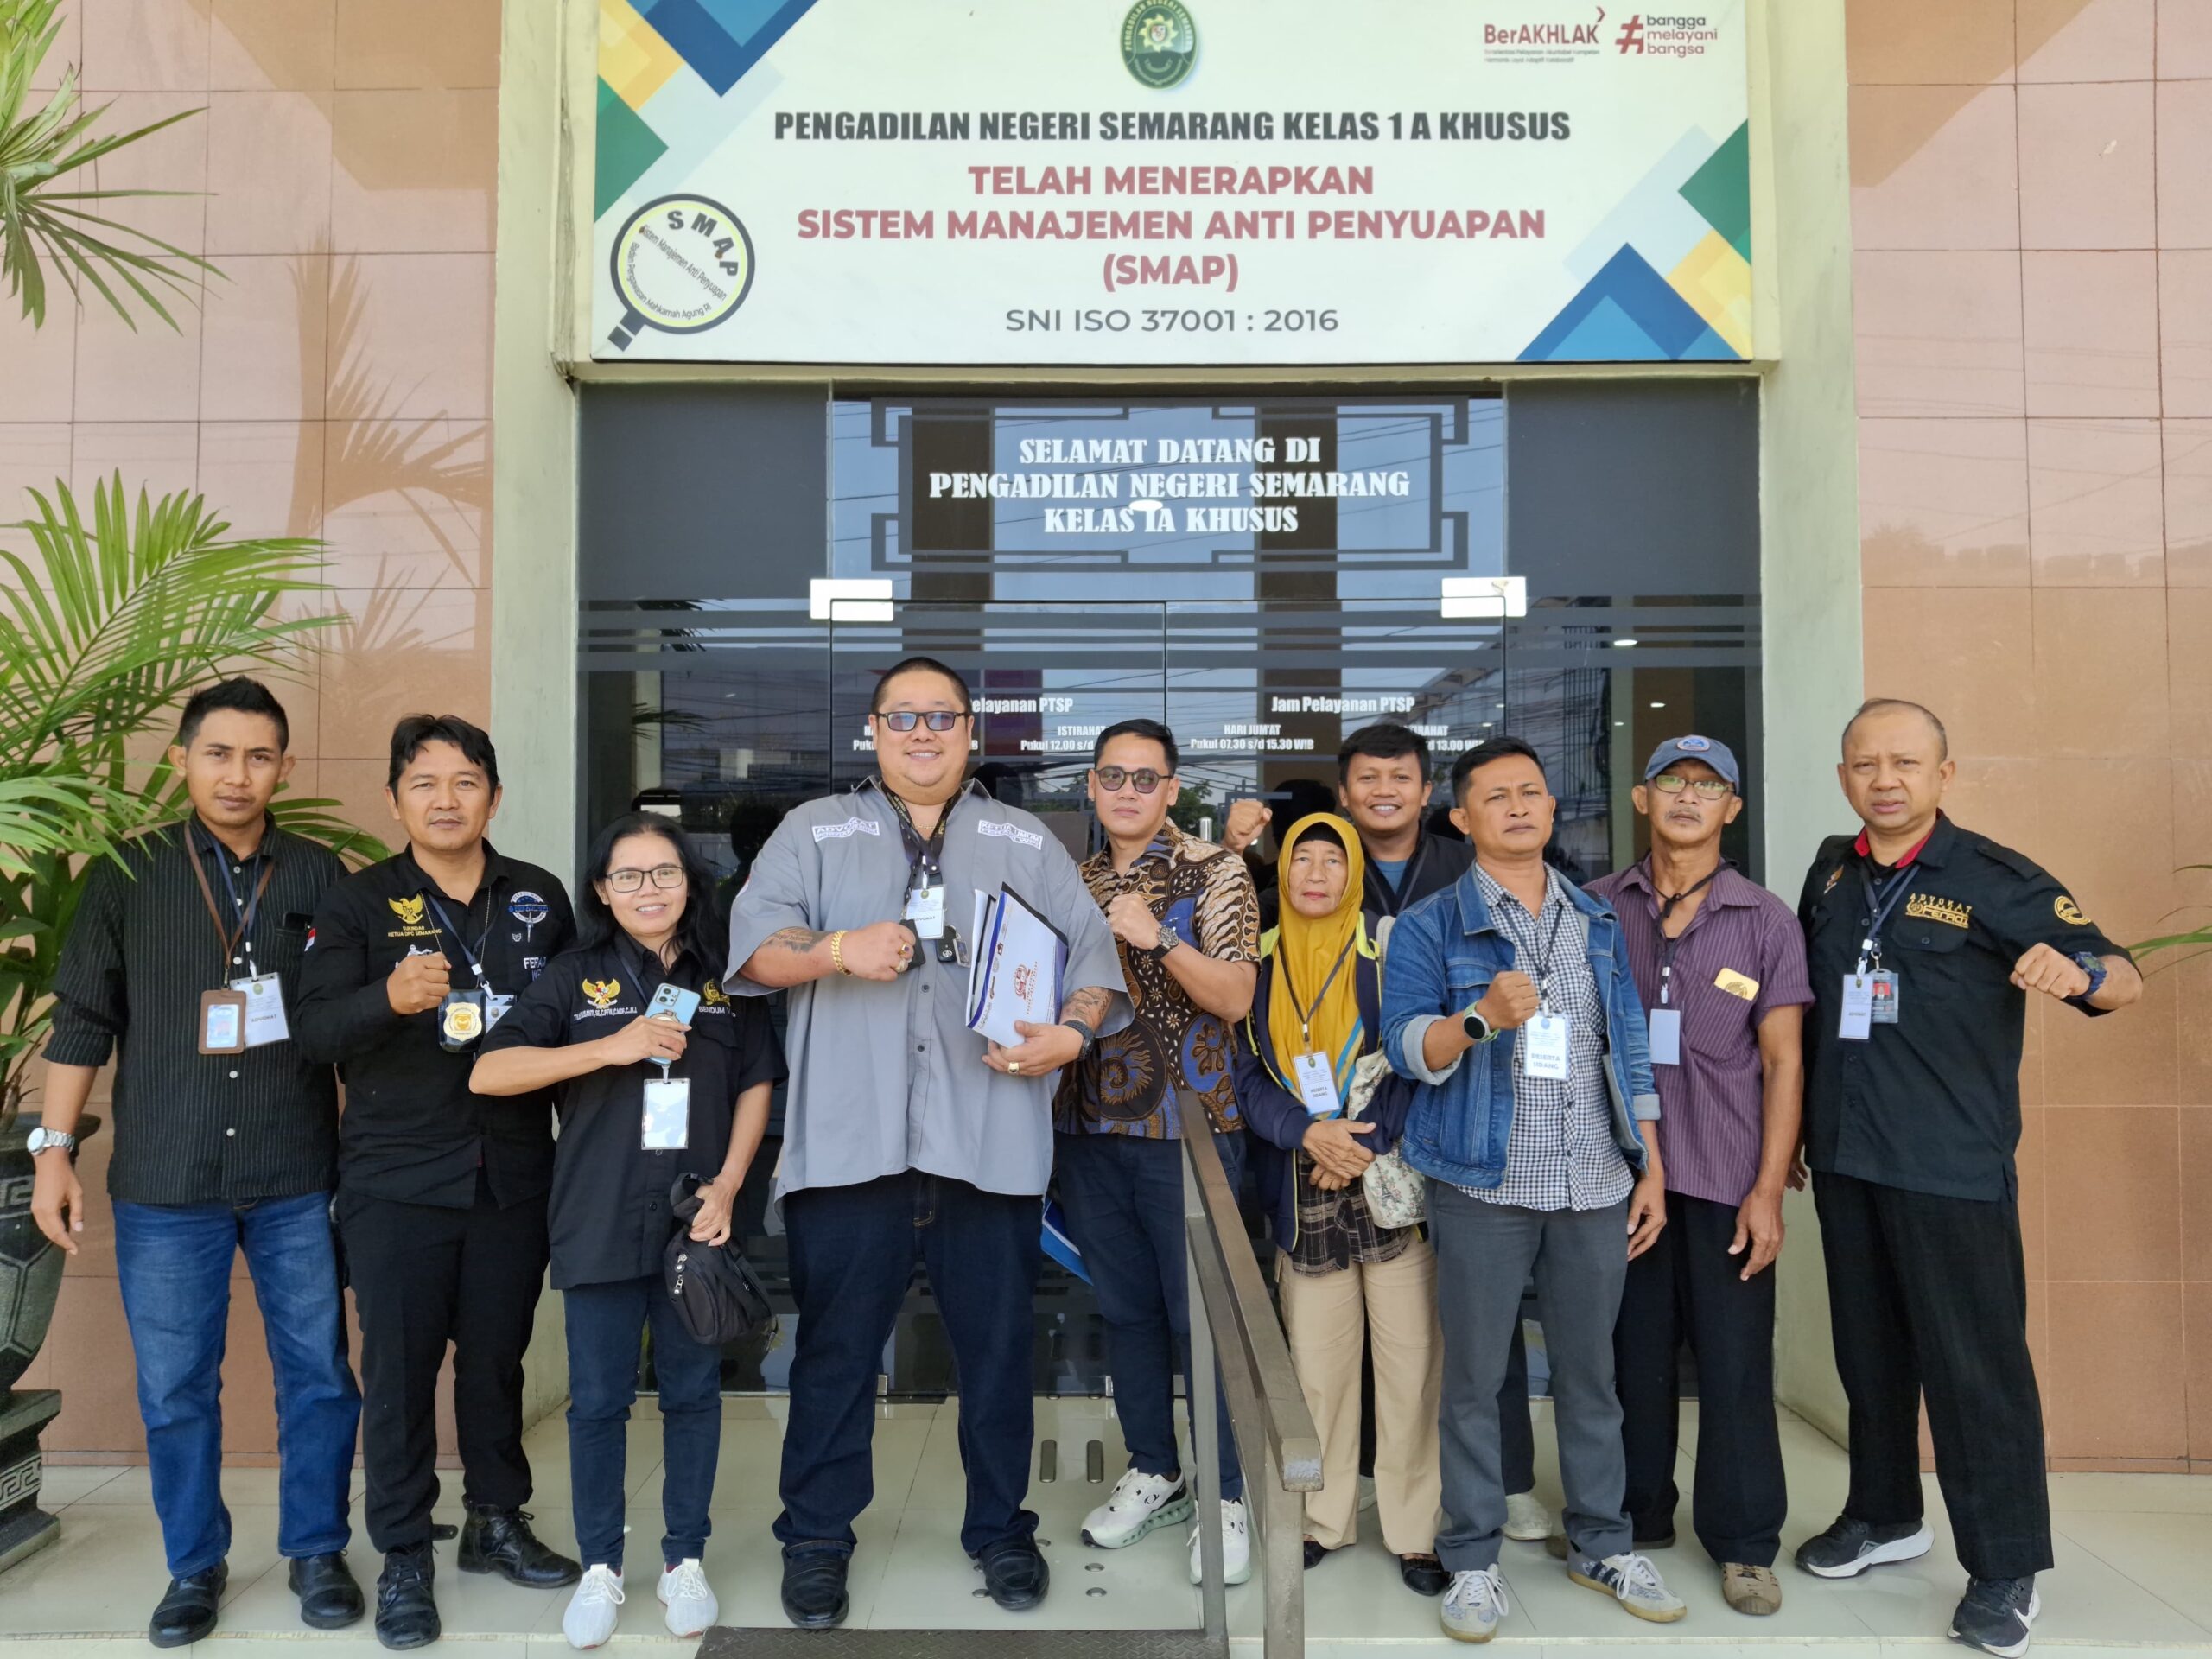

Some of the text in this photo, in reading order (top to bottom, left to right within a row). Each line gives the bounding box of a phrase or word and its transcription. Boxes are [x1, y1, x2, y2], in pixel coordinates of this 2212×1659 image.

[1646, 15, 1707, 29] bangga
[1484, 24, 1599, 44] BerAKHLAK
[1646, 29, 1718, 43] melayani
[1646, 43, 1705, 58] bangsa
[775, 111, 1571, 141] PENGADILAN NEGERI SEMARANG KELAS 1 A KHUSUS
[968, 166, 1373, 194] TELAH MENERAPKAN
[798, 209, 1545, 239] SISTEM MANAJEMEN ANTI PENYUAPAN
[658, 238, 690, 270] Manajemen
[686, 263, 702, 278] Anti
[696, 271, 728, 302] Penyuapan
[1103, 254, 1239, 293] (SMAP)
[626, 264, 648, 302] Pengawasan
[645, 299, 681, 319] Mahkamah
[682, 304, 705, 320] Agung
[1006, 309, 1061, 332] SNI
[1075, 309, 1131, 332] ISO
[1141, 309, 1235, 333] 37001
[1263, 309, 1339, 332] 2016
[1020, 437, 1321, 464] SELAMAT DATANG DI
[930, 472, 1409, 499] PENGADILAN NEGERI SEMARANG
[1044, 508, 1135, 533] KELAS
[1186, 507, 1299, 532] KHUSUS
[971, 697, 1073, 714] elayanan PTSP
[1271, 696, 1416, 714] Jam Pelayanan PTSP
[1058, 726, 1107, 736] ISTIRAHAT
[1224, 724, 1247, 735] HARI
[1403, 724, 1449, 736] TIRAHAT
[853, 739, 874, 750] Puk
[1020, 739, 1094, 751] Pukul 12.00 s/d
[1190, 739, 1314, 750] Pukul 07.30 s/d 15.30 WIB
[1436, 740, 1464, 751] 13.00
[523, 957, 547, 969] FERA
